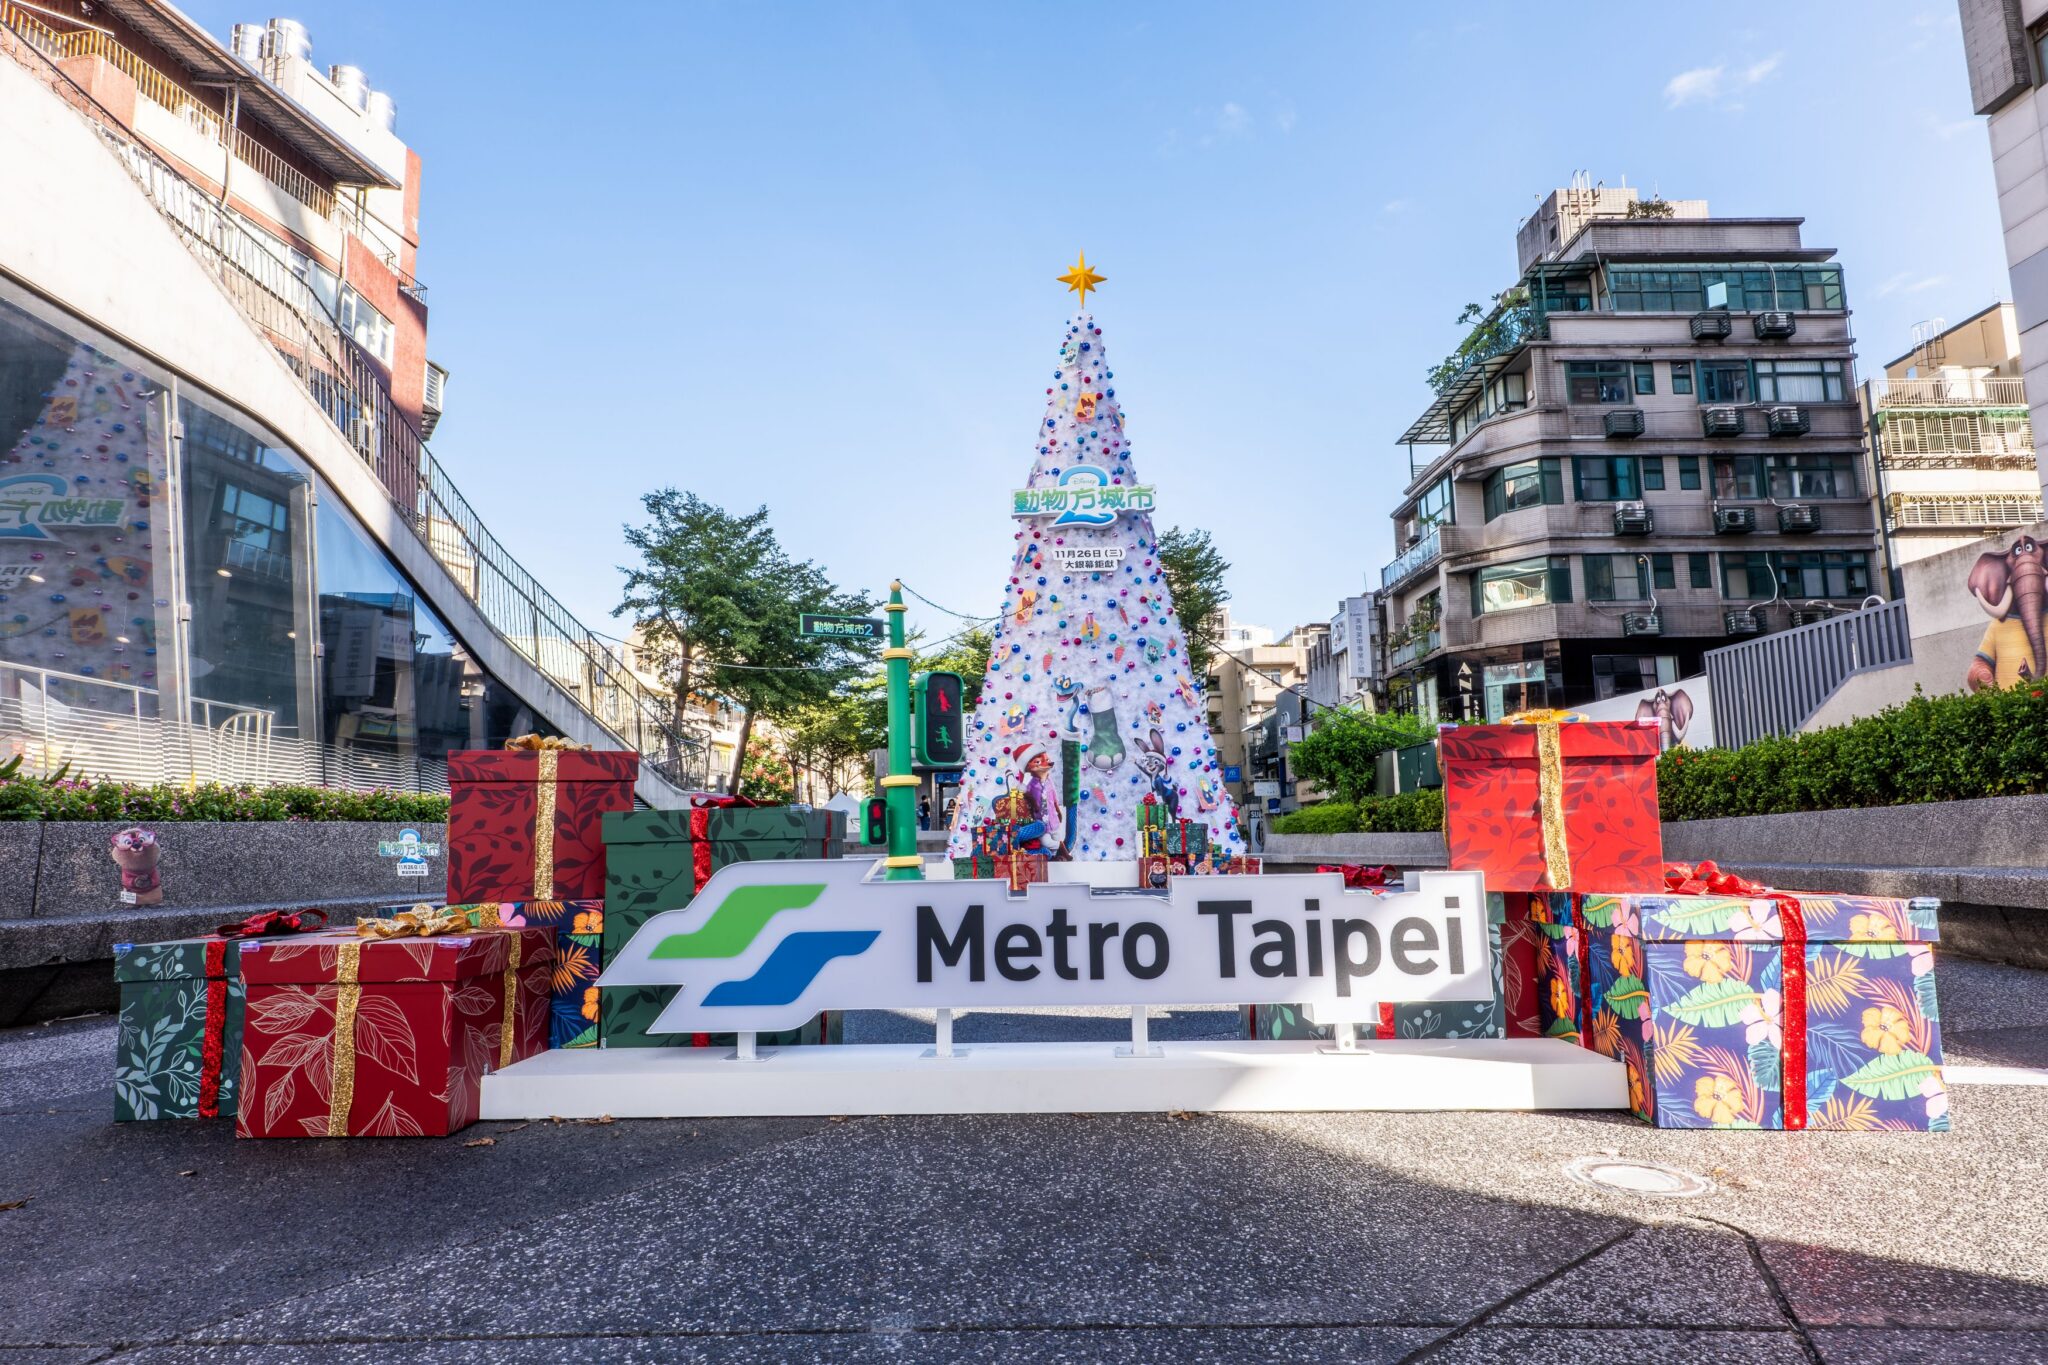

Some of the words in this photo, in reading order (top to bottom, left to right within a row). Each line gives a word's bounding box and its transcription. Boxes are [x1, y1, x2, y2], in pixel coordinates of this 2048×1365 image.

[1014, 485, 1153, 513] 動物方城市
[813, 621, 873, 636] 動物方城市2
[915, 904, 1170, 982] Metro
[1197, 896, 1466, 998] Taipei
